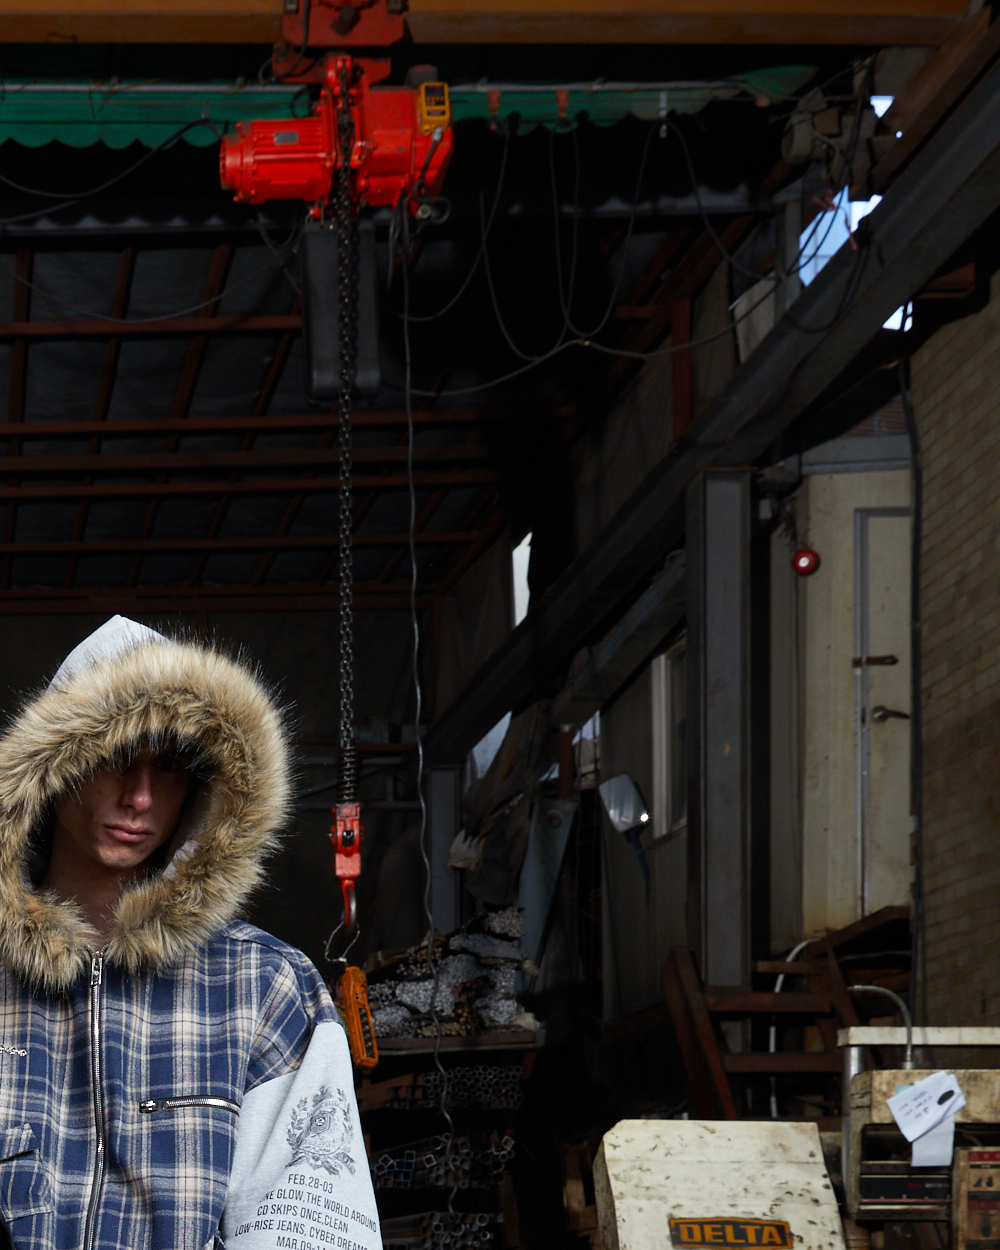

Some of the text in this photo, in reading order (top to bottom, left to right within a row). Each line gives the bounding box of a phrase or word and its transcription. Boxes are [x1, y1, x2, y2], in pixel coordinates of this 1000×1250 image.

[288, 1174, 333, 1194] FEB.28-03
[257, 1204, 268, 1216] CD
[270, 1204, 298, 1216] SKIPS
[260, 1190, 275, 1202] NE
[324, 1198, 350, 1218] WORLD
[351, 1210, 377, 1232] AROUND
[235, 1220, 274, 1236] LOW-RISE
[276, 1220, 306, 1236] JEANS,
[309, 1226, 336, 1245] CYBER
[680, 1224, 783, 1244] DELTA
